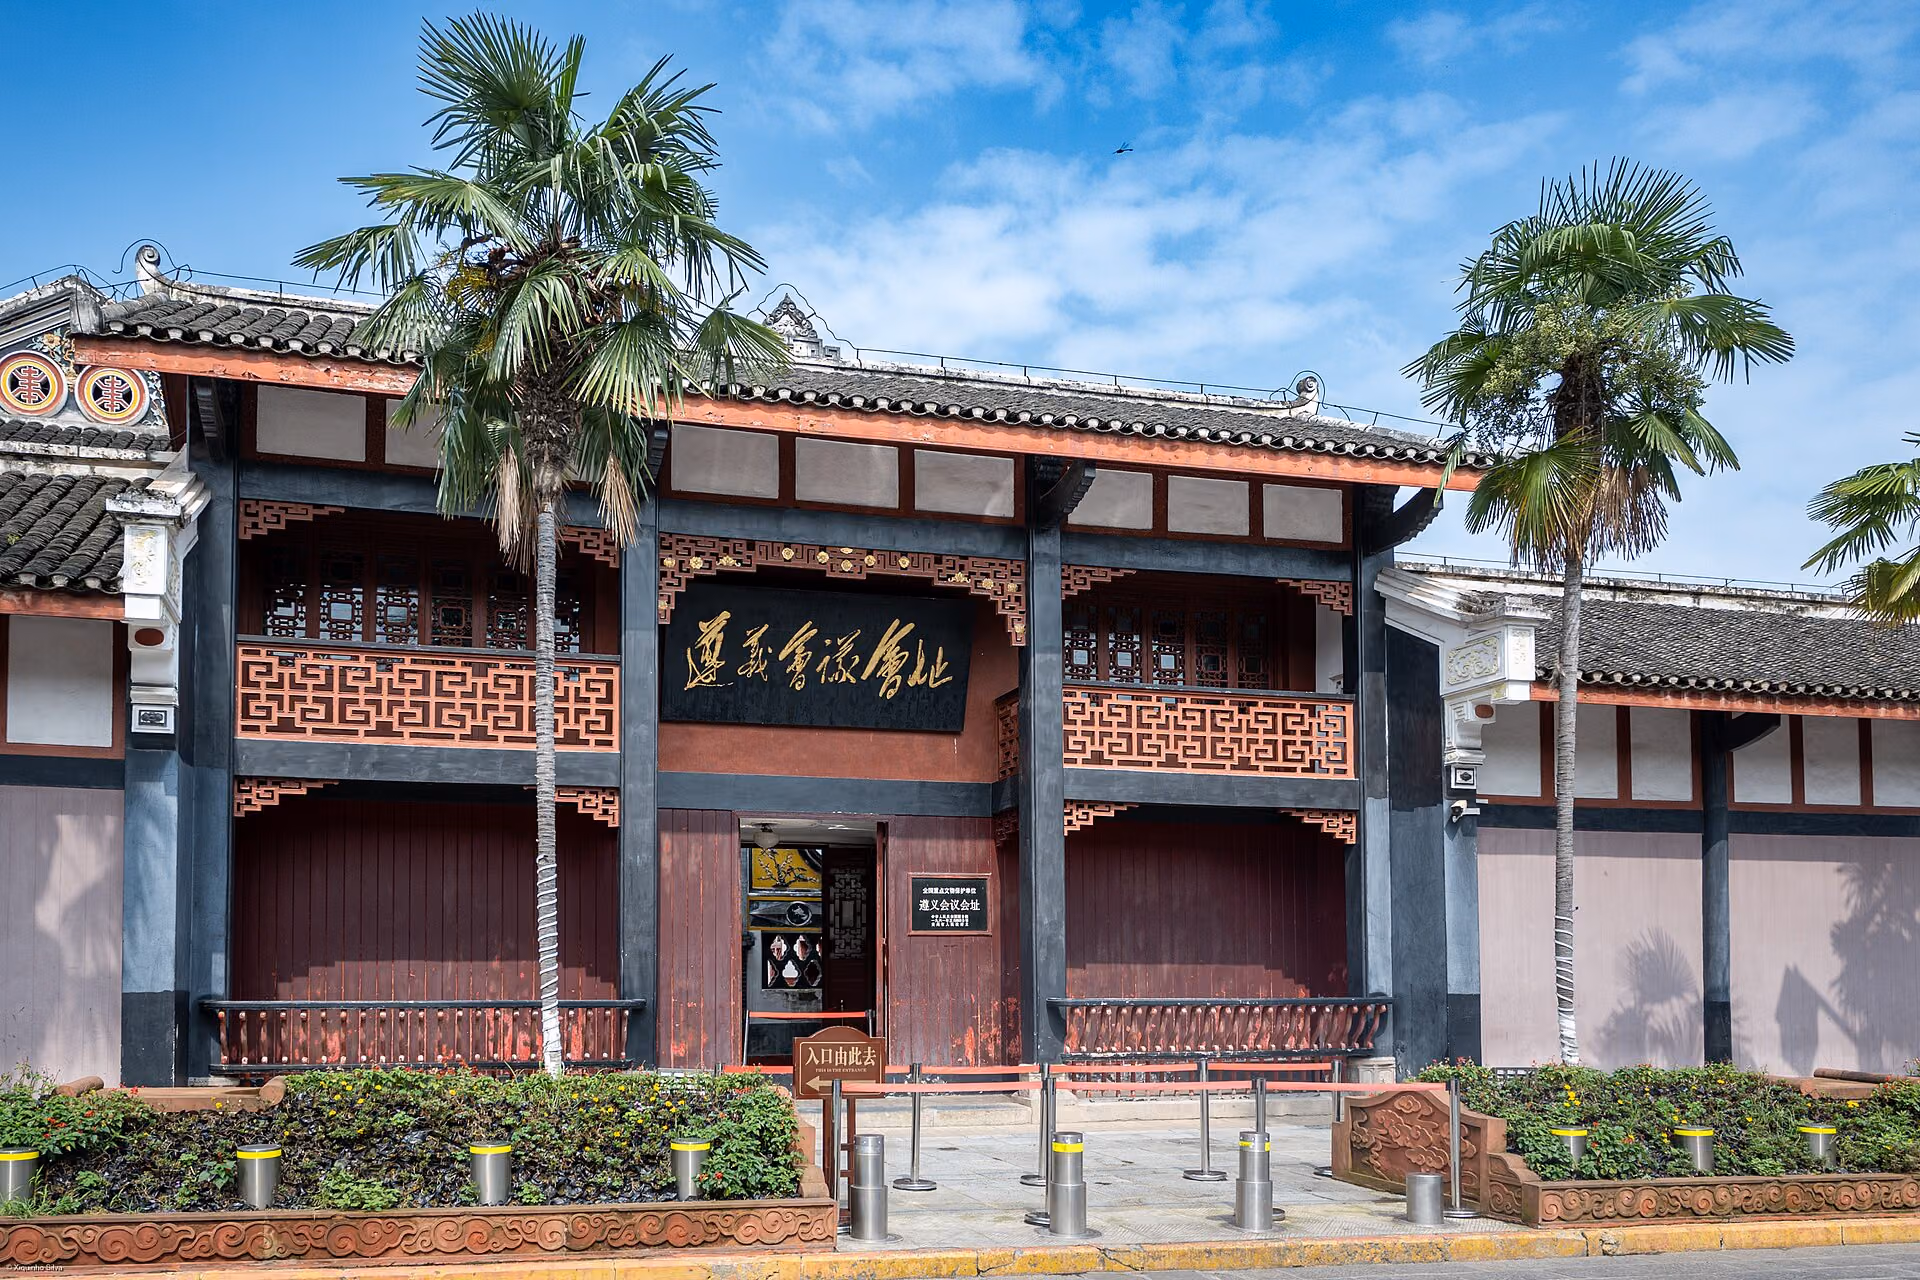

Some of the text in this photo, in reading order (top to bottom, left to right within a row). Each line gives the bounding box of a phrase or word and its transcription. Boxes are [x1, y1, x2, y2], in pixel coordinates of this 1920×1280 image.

[918, 899, 981, 911] 遵义会议会址
[805, 1046, 877, 1067] 入口由此去
